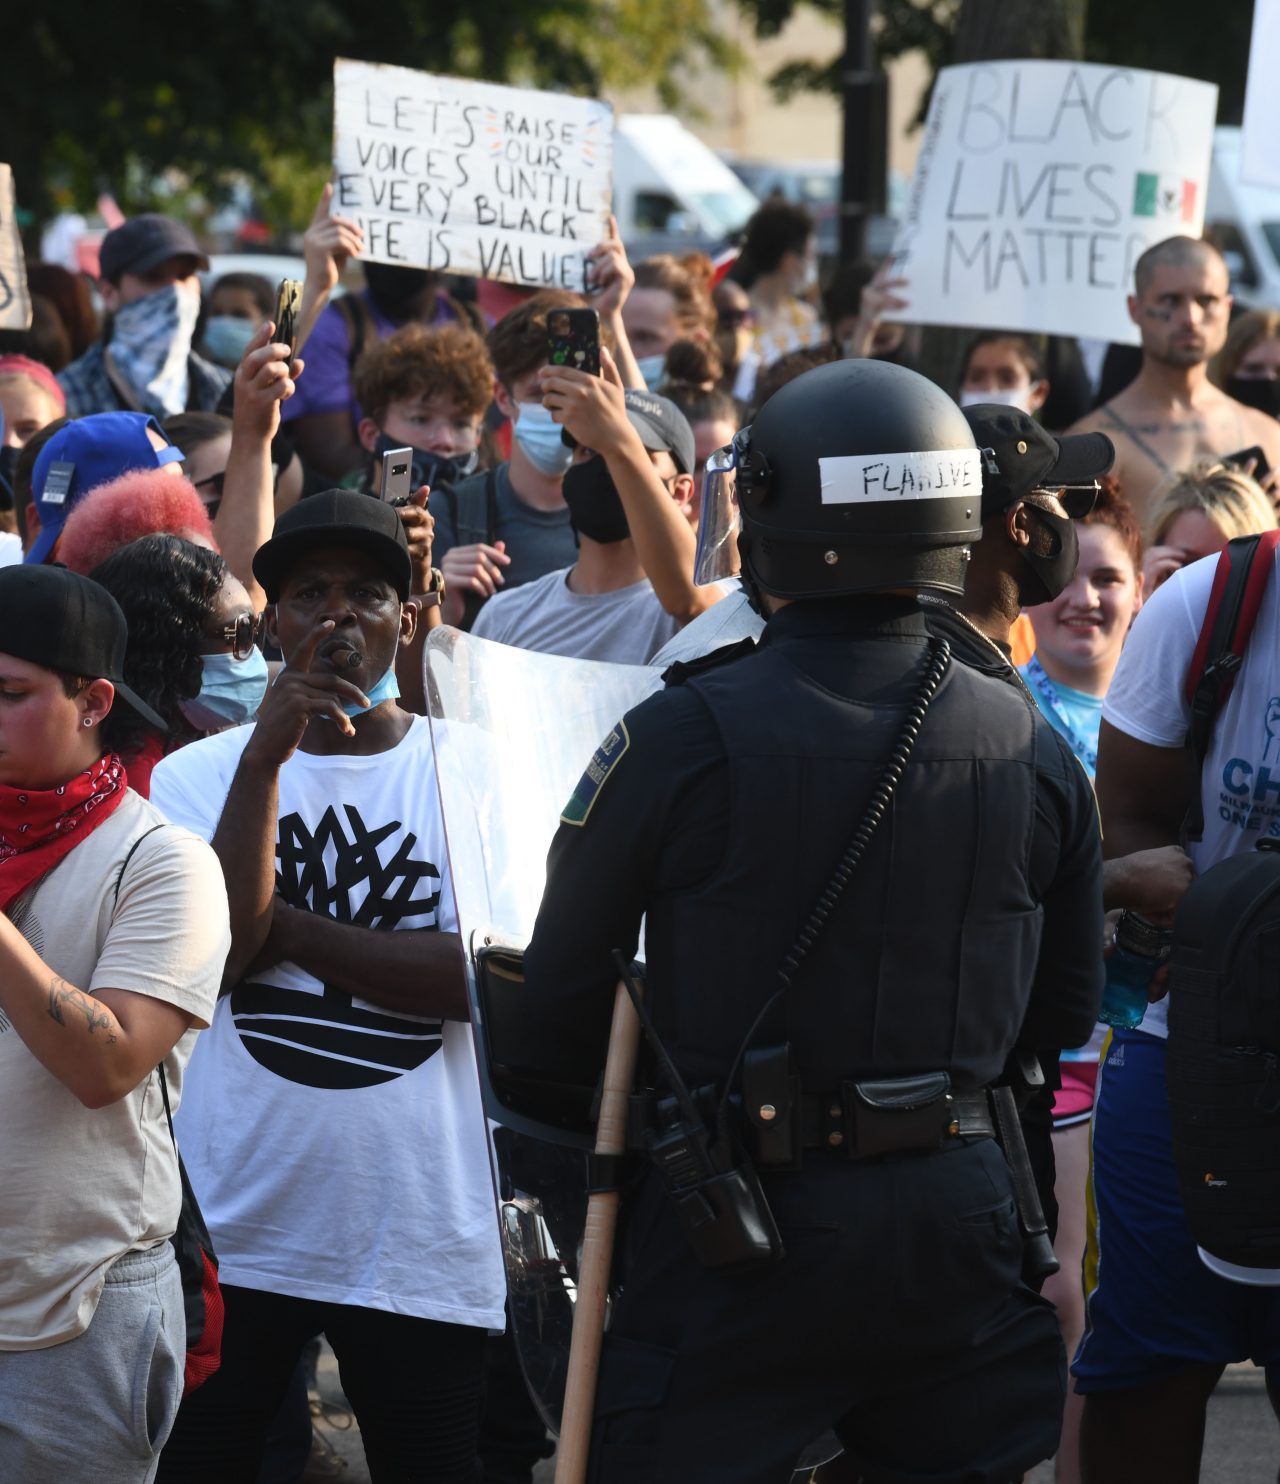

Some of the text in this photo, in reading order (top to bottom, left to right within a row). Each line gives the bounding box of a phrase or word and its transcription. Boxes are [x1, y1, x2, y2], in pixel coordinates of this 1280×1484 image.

[365, 90, 577, 148] LET'S RAISE
[957, 66, 1181, 157] BLACK
[356, 137, 595, 213] VOICES UNTIL
[505, 138, 563, 170] OUR
[338, 174, 578, 240] EVERY BLACK
[946, 158, 1122, 228] LIVES
[358, 217, 405, 259] IFE
[427, 229, 452, 272] IS
[1220, 806, 1262, 831] ONE
